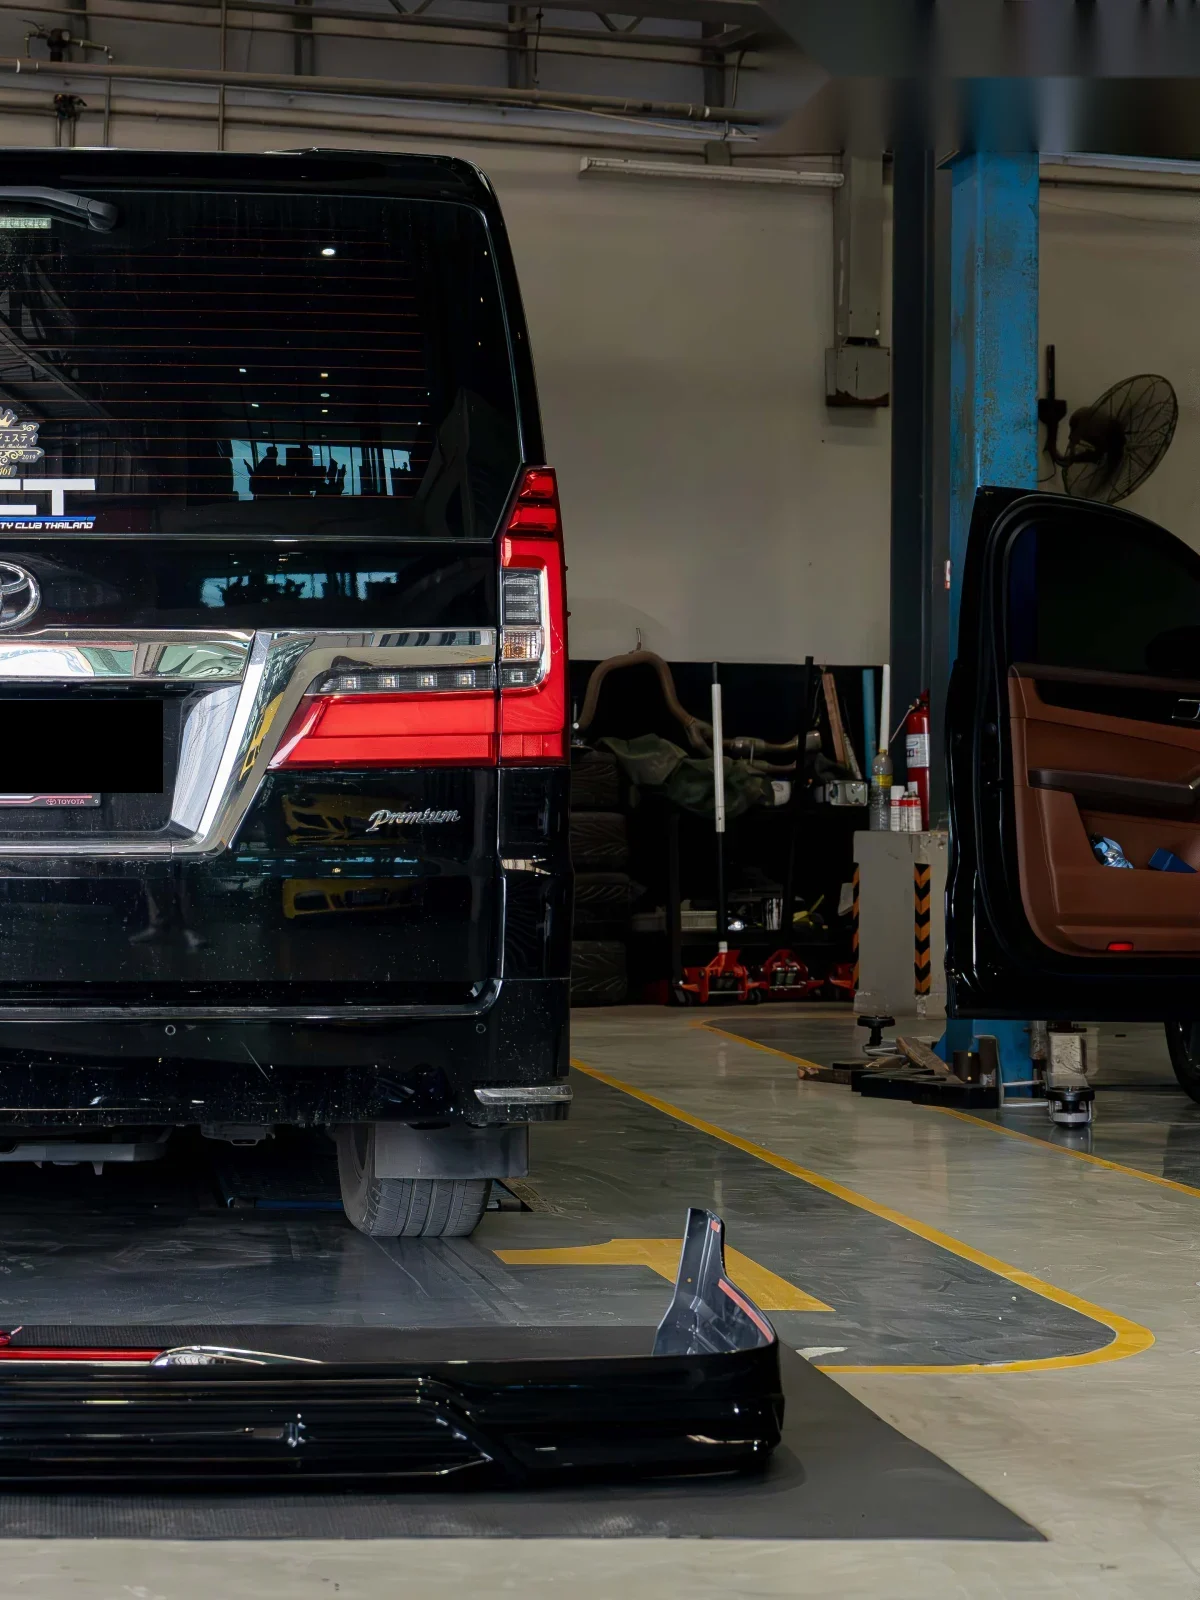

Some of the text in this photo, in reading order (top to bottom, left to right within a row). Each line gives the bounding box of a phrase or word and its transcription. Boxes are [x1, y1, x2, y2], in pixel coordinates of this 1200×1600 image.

[15, 521, 42, 529] CLUB
[45, 521, 94, 529] THAILAND
[365, 807, 461, 832] Premium
